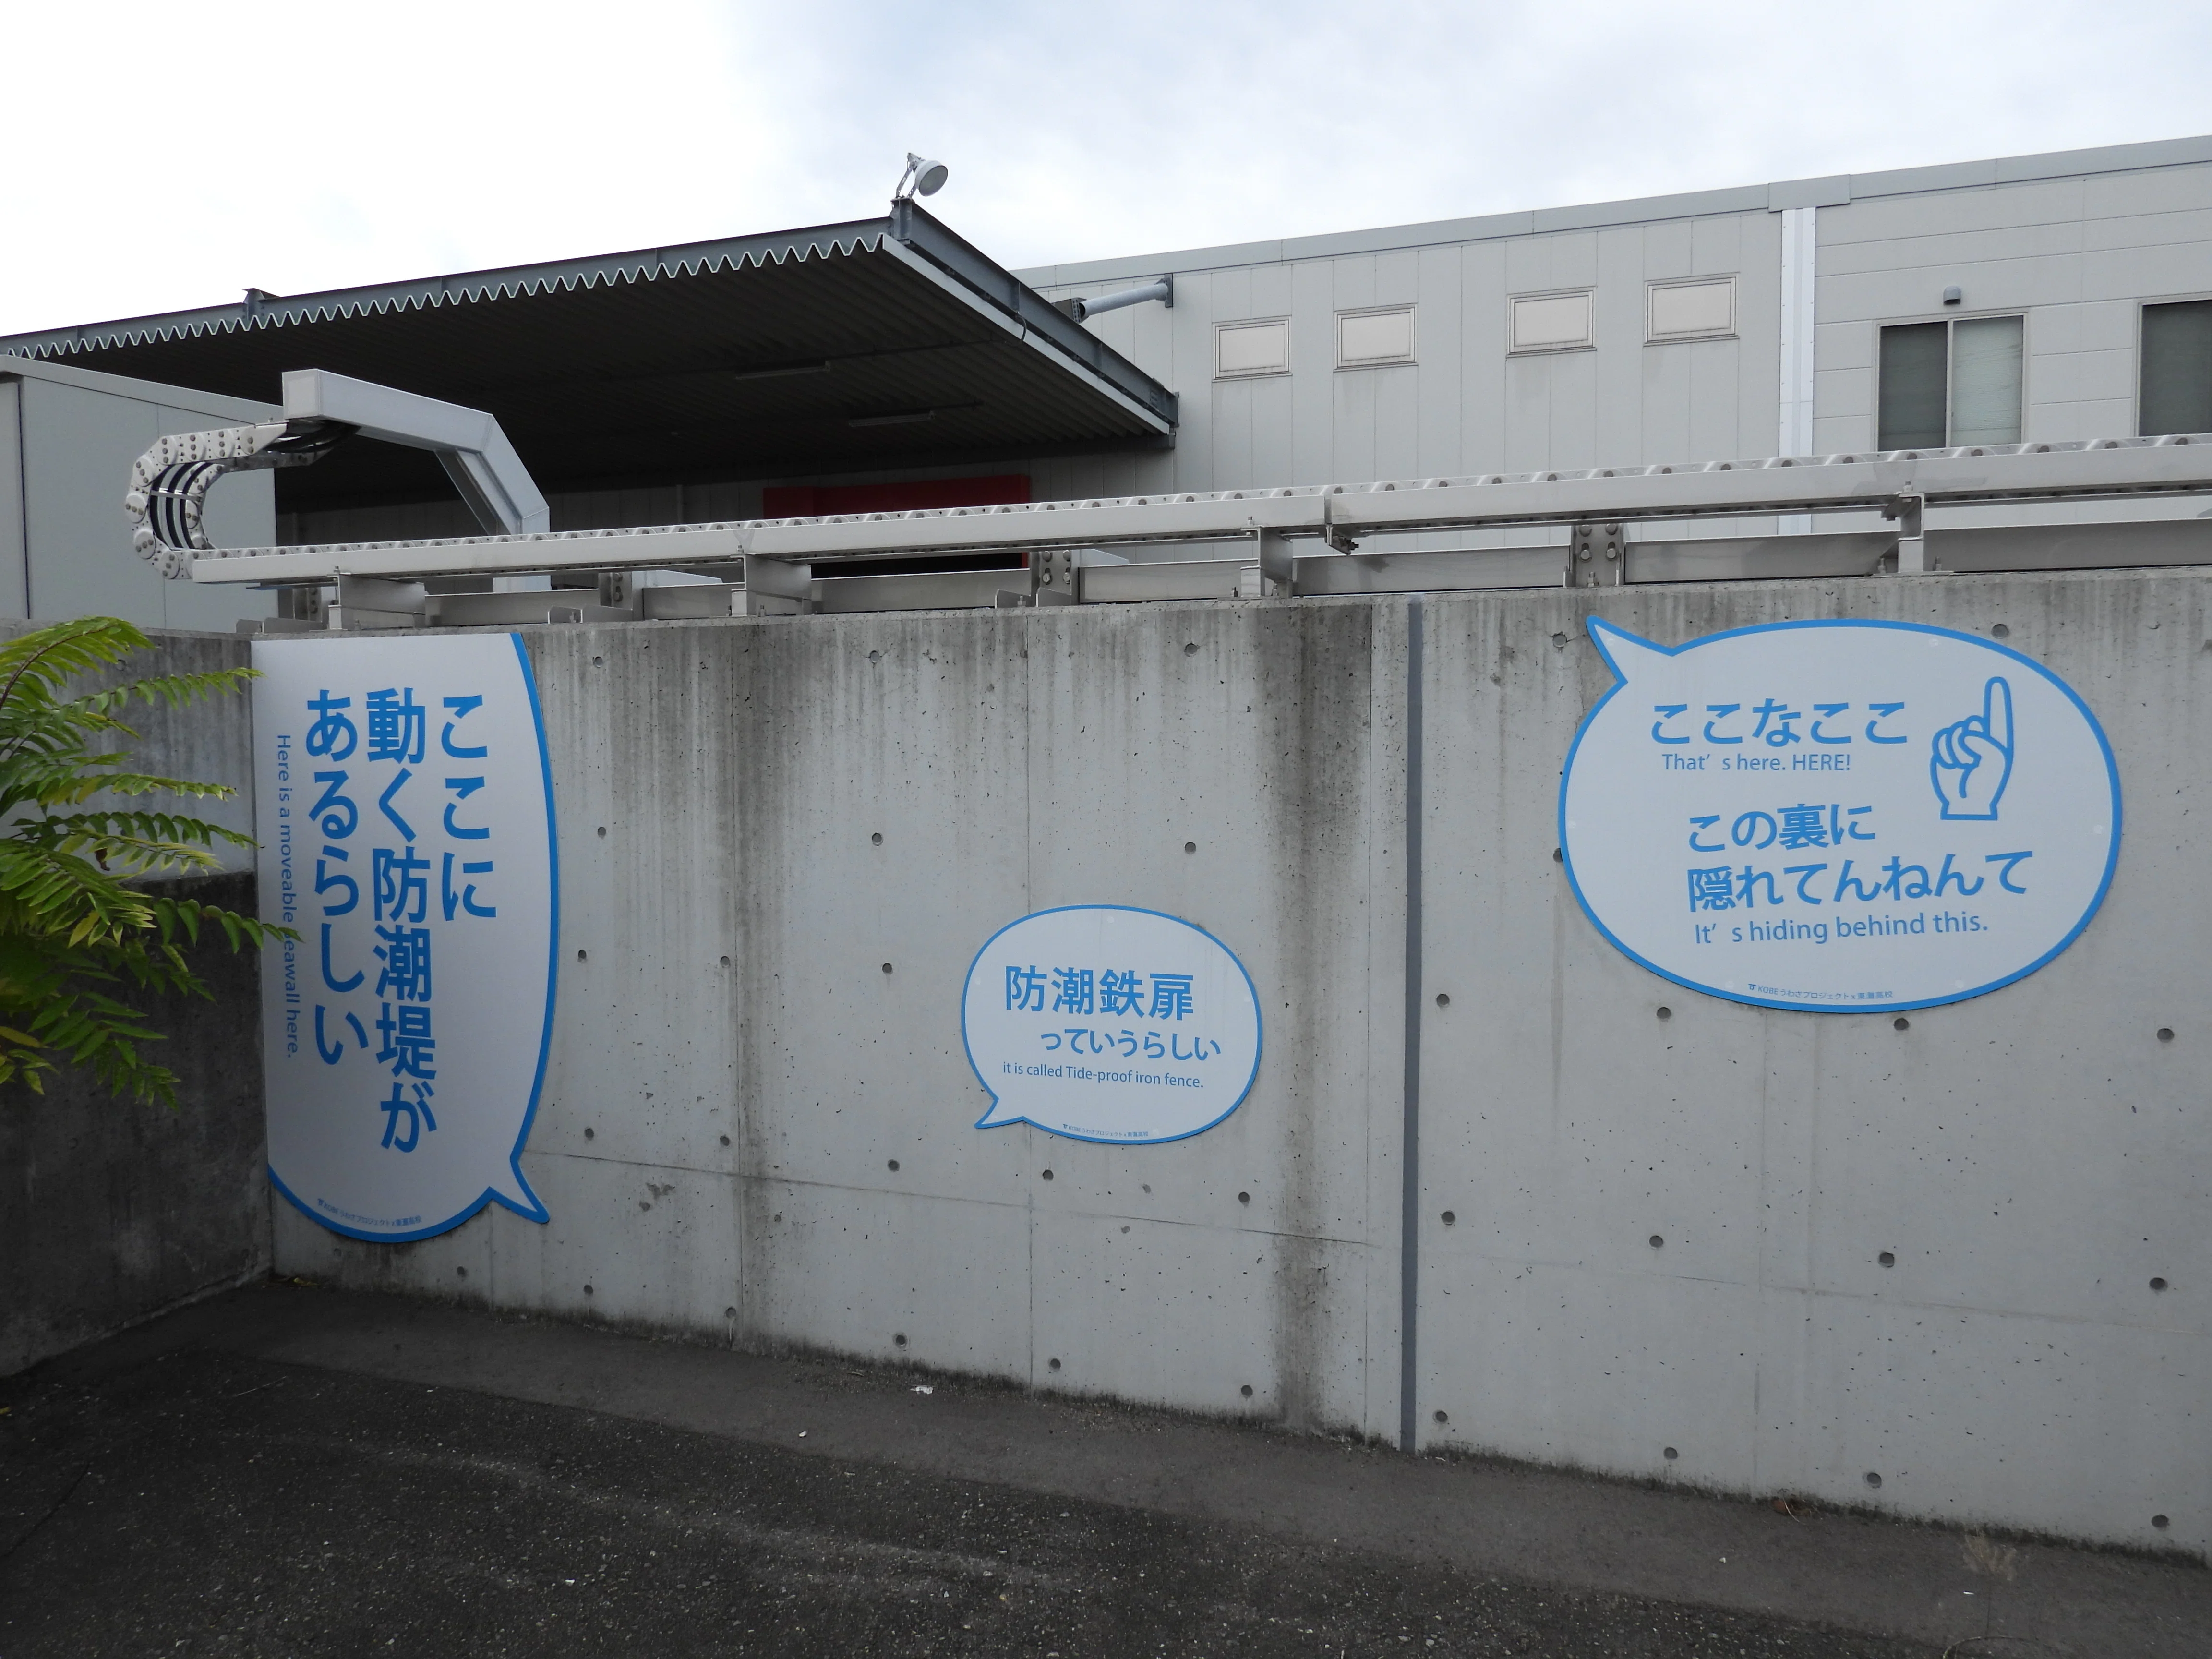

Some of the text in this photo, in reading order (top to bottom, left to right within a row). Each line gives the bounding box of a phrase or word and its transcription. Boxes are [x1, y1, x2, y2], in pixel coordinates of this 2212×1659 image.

[1650, 698, 1908, 748] ここなここ
[277, 735, 291, 781] Here
[1737, 753, 1786, 771] here.
[1792, 754, 1851, 771] HERE!
[279, 787, 293, 802] is
[279, 807, 290, 818] a
[441, 694, 497, 922] ここに
[1688, 803, 1876, 854] この裏に
[280, 824, 297, 923] moveable
[305, 689, 369, 1065] あるらしい
[1687, 850, 2034, 914] 隠れてんねんて
[366, 687, 437, 1153] 動く防潮堤が
[1749, 918, 1828, 945] hiding
[1836, 913, 1925, 938] behind
[1933, 911, 1989, 934] this.
[1005, 965, 1194, 1021] 防潮鉄扉
[286, 1009, 301, 1058] here.
[1041, 1028, 1222, 1061] っていうらしい
[1003, 1061, 1203, 1088] it is called Tide-proof iron fence.
